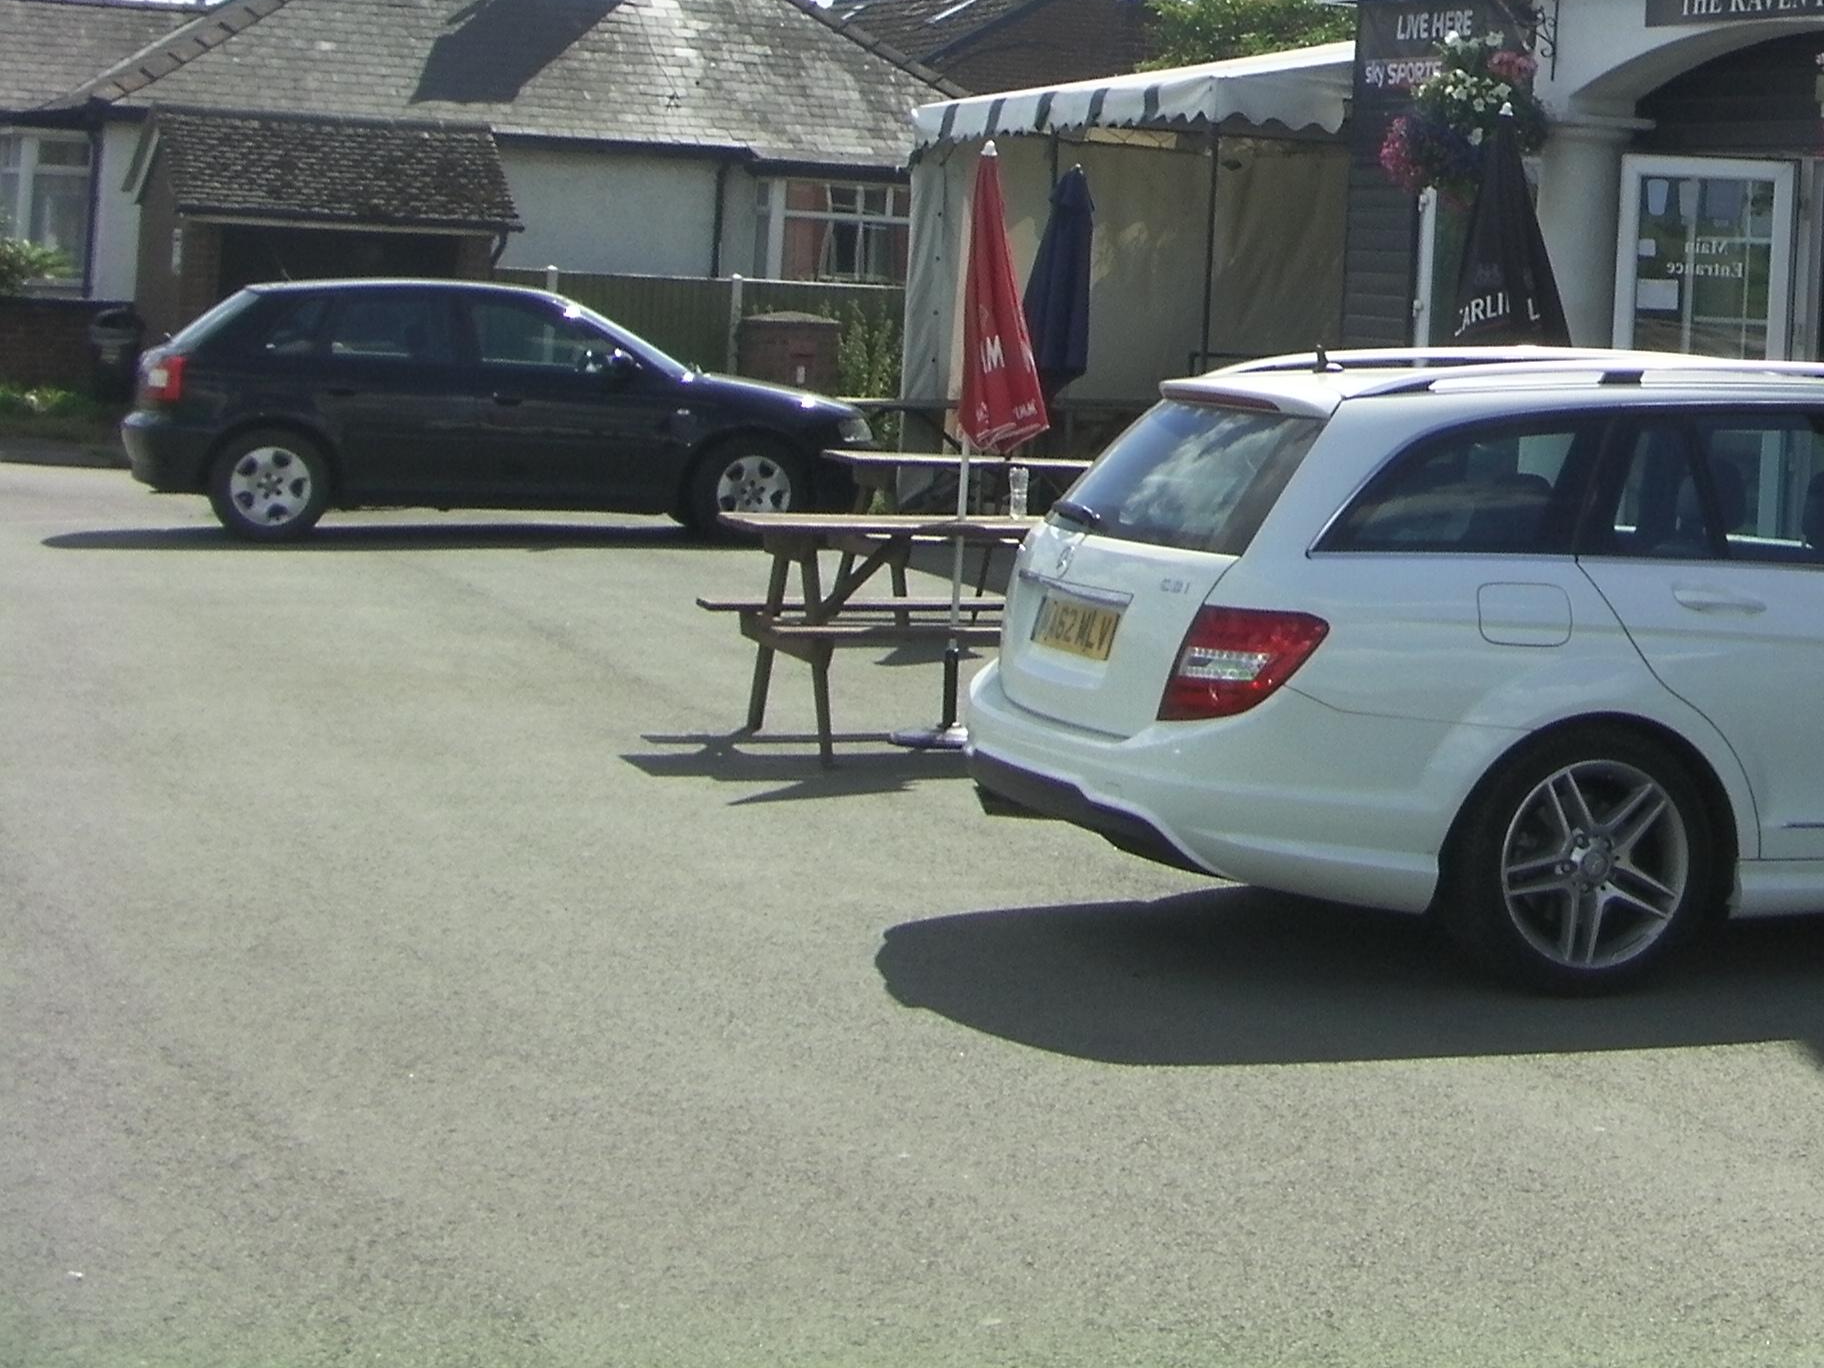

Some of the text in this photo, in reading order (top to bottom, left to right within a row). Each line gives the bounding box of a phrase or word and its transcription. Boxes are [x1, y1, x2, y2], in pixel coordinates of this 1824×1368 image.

[1397, 9, 1473, 40] LIVE HERE
[1365, 60, 1386, 88] sky
